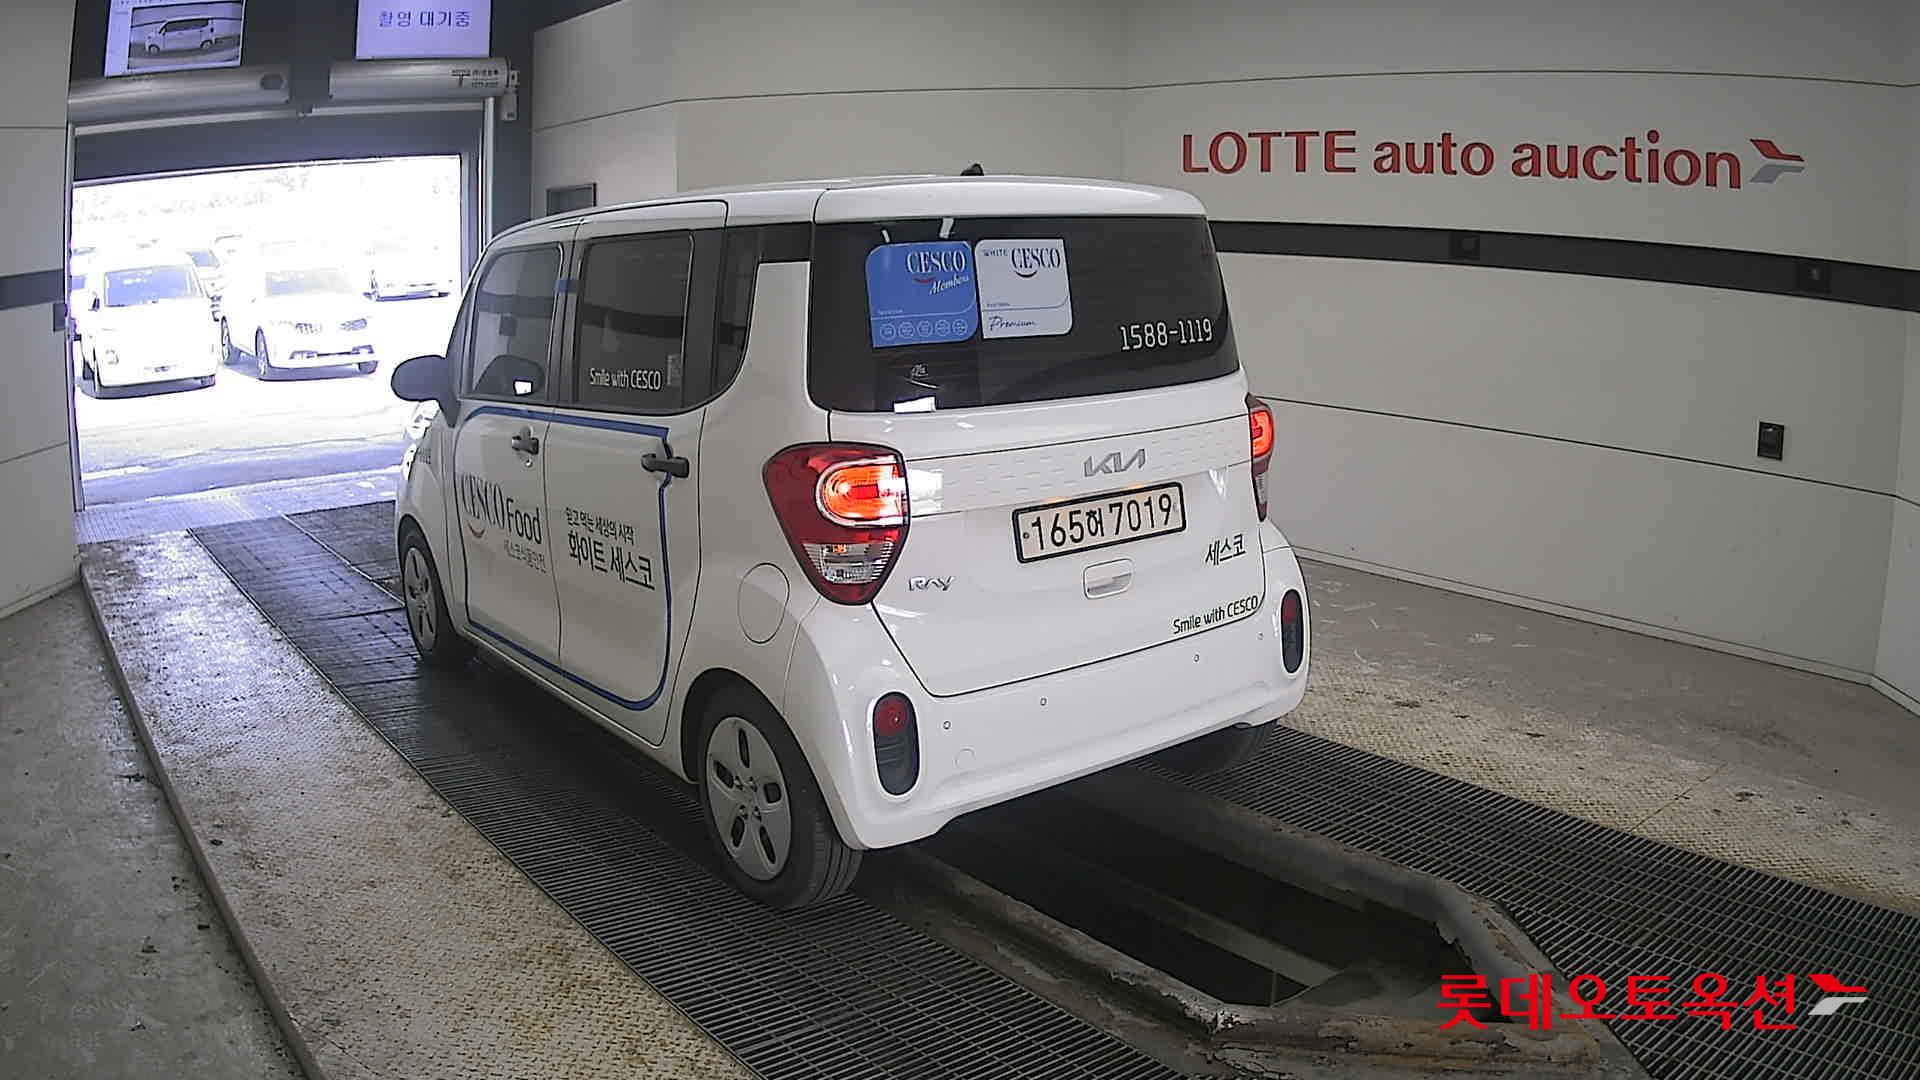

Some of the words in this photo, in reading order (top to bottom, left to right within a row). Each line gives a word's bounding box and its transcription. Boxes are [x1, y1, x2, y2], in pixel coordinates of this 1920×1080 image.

[420, 10, 470, 28] 대기중
[1182, 130, 1356, 174] LOTTE
[1373, 132, 1494, 175] auto
[1511, 129, 1741, 189] auction
[906, 249, 966, 273] CESCO
[1011, 247, 1061, 269] CESCO
[1120, 318, 1213, 350] 1588-1119
[590, 367, 610, 386] Smile
[611, 369, 629, 388] with
[630, 369, 661, 390] CESCO
[1084, 448, 1146, 477] KIA
[460, 474, 505, 530] CESCO
[506, 497, 541, 544] Food
[568, 530, 608, 573] 화이트
[610, 546, 655, 590] 세스코
[1205, 533, 1246, 566] 세스코
[1173, 615, 1202, 634] Smile
[1203, 605, 1226, 625] with
[1227, 595, 1259, 617] CESCO
